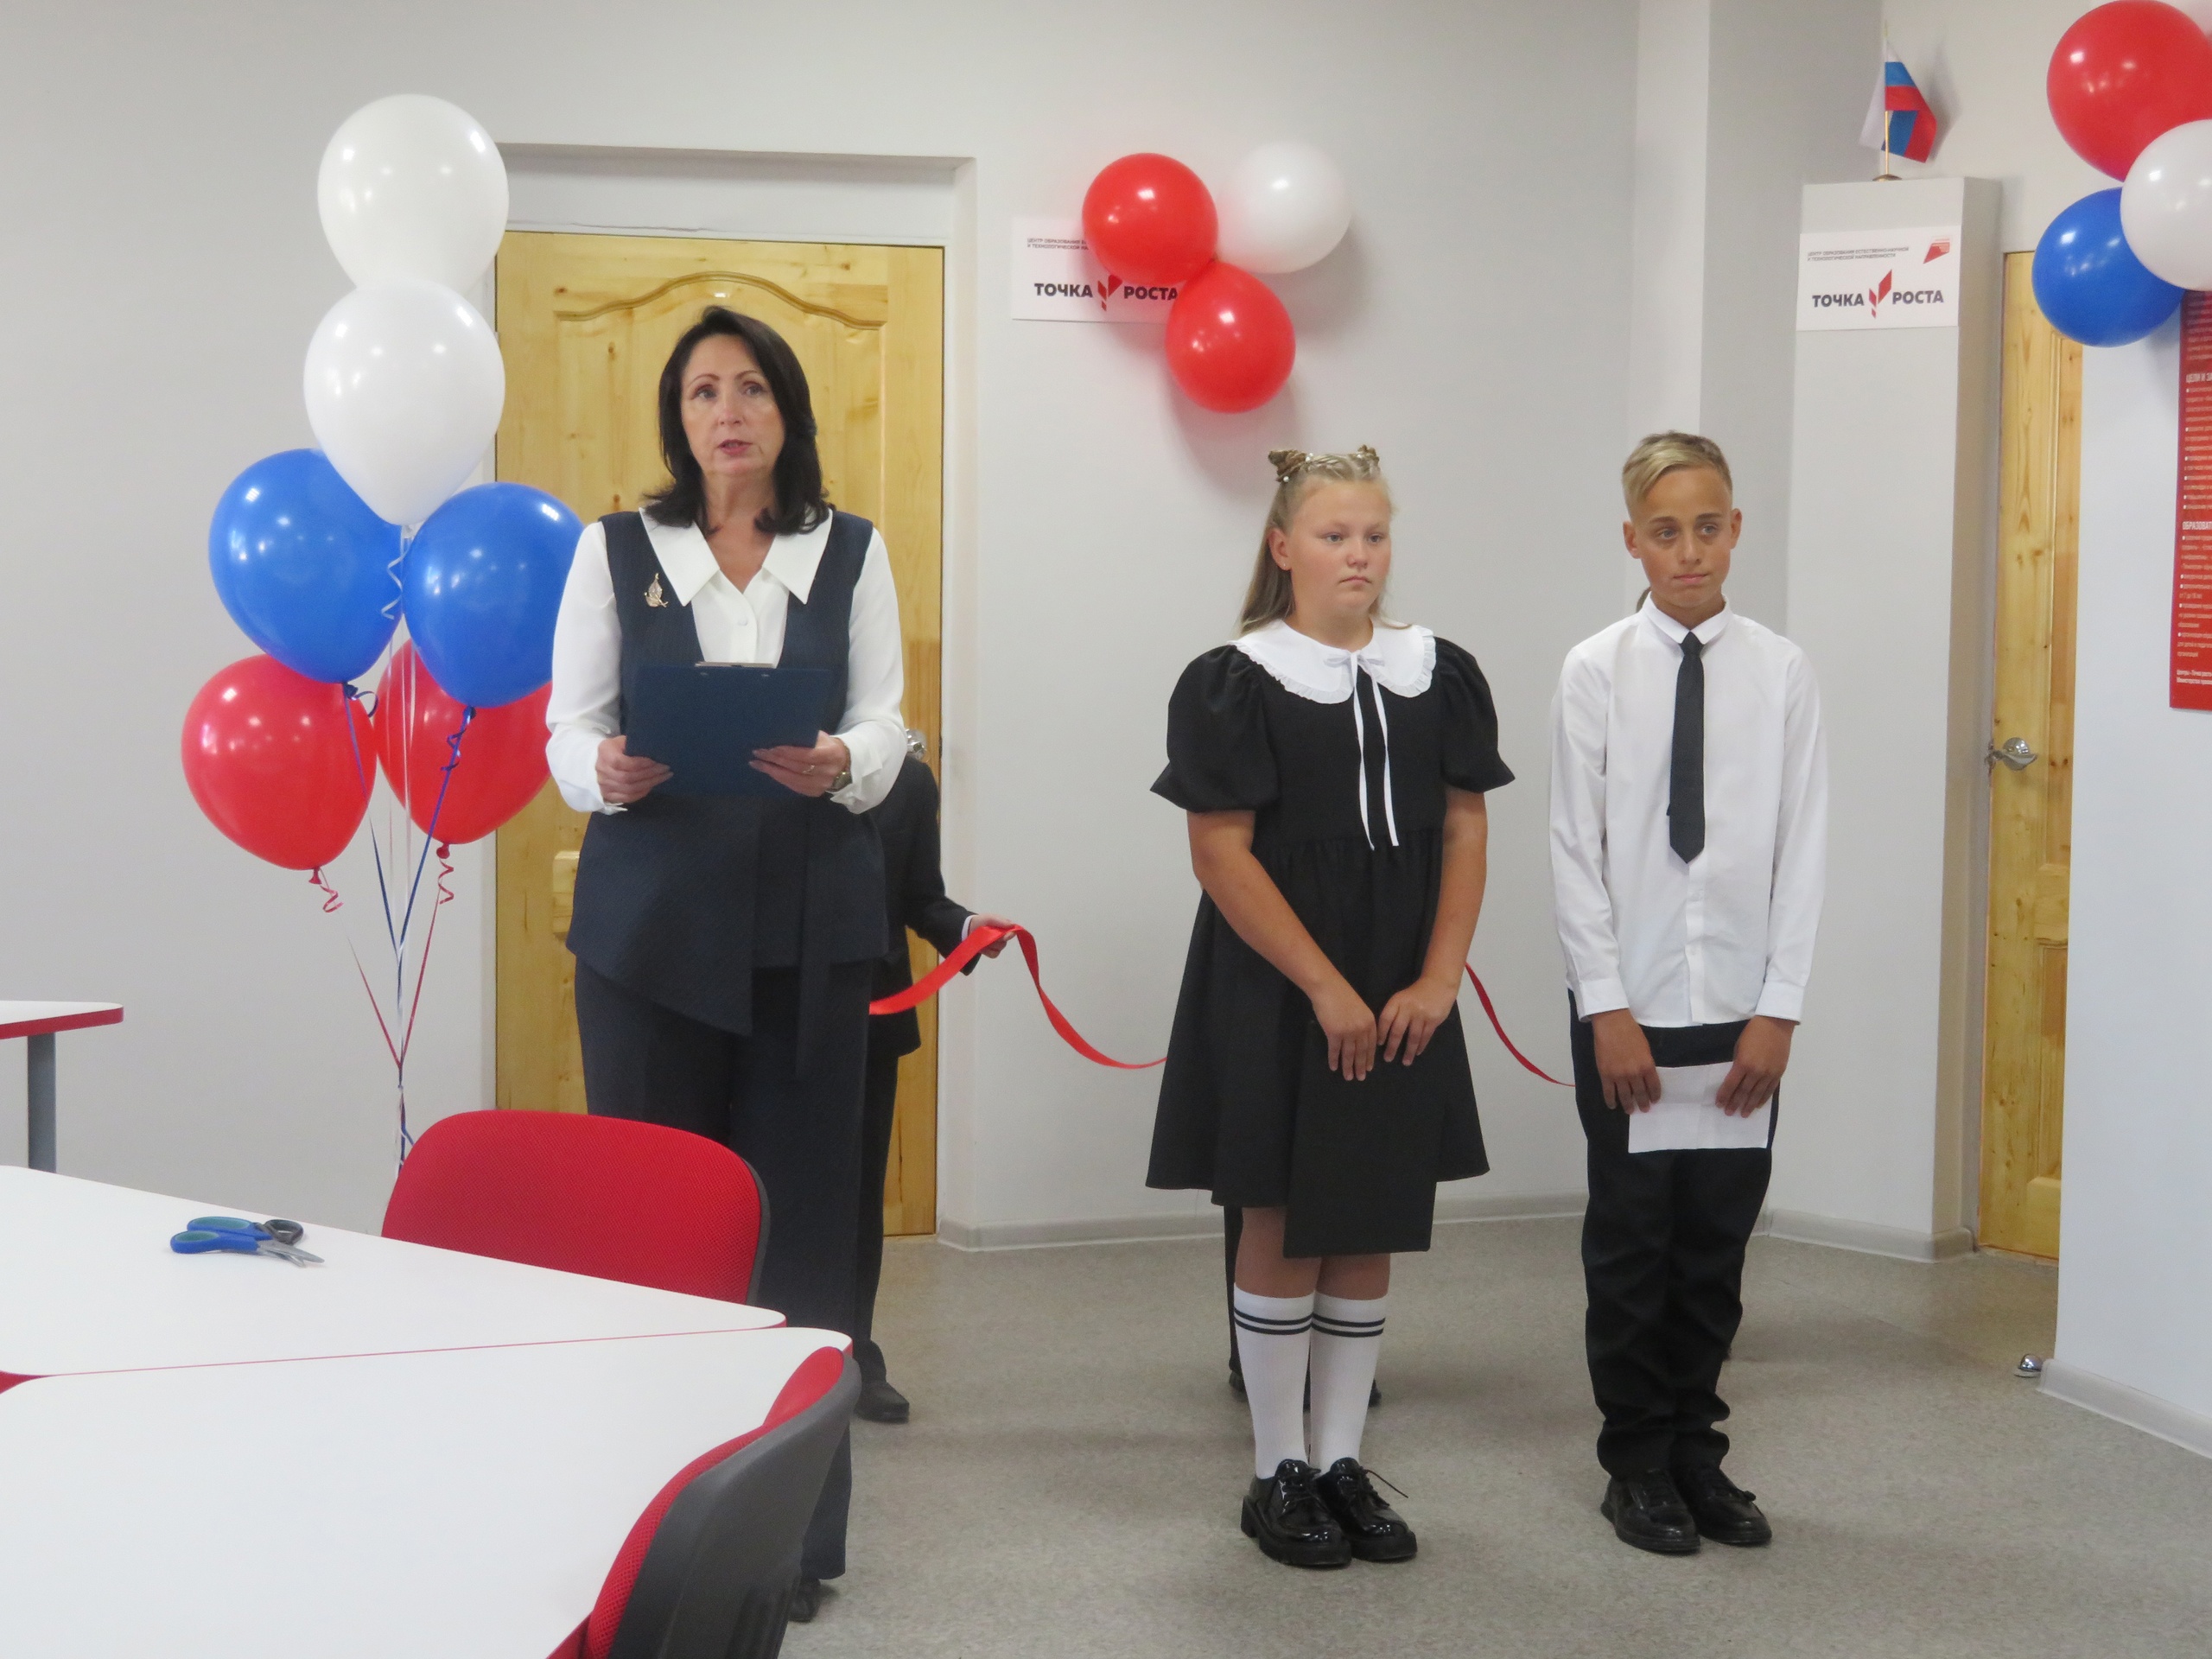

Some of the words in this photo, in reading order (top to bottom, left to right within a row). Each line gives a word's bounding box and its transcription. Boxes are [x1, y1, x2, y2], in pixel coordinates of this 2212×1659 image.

[1034, 283, 1093, 298] ТОЧКА
[1123, 285, 1179, 301] РОСТА
[1812, 293, 1865, 308] ТОЧКА
[1891, 289, 1944, 305] РОСТА
